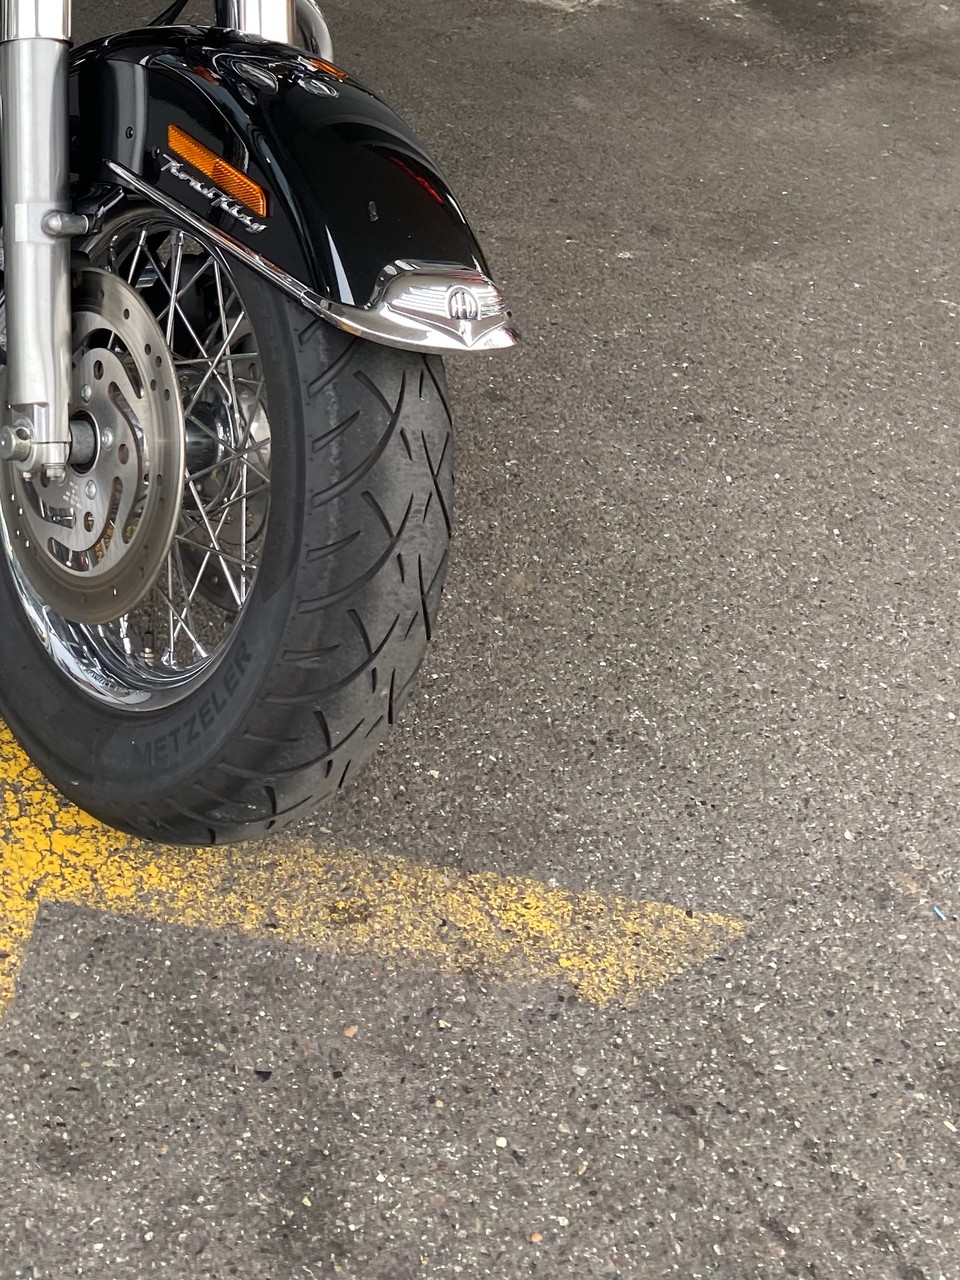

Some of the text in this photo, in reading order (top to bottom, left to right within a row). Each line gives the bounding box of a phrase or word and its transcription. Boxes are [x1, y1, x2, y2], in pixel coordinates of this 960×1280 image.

[161, 153, 268, 234] Road King
[137, 641, 253, 766] METZELER
